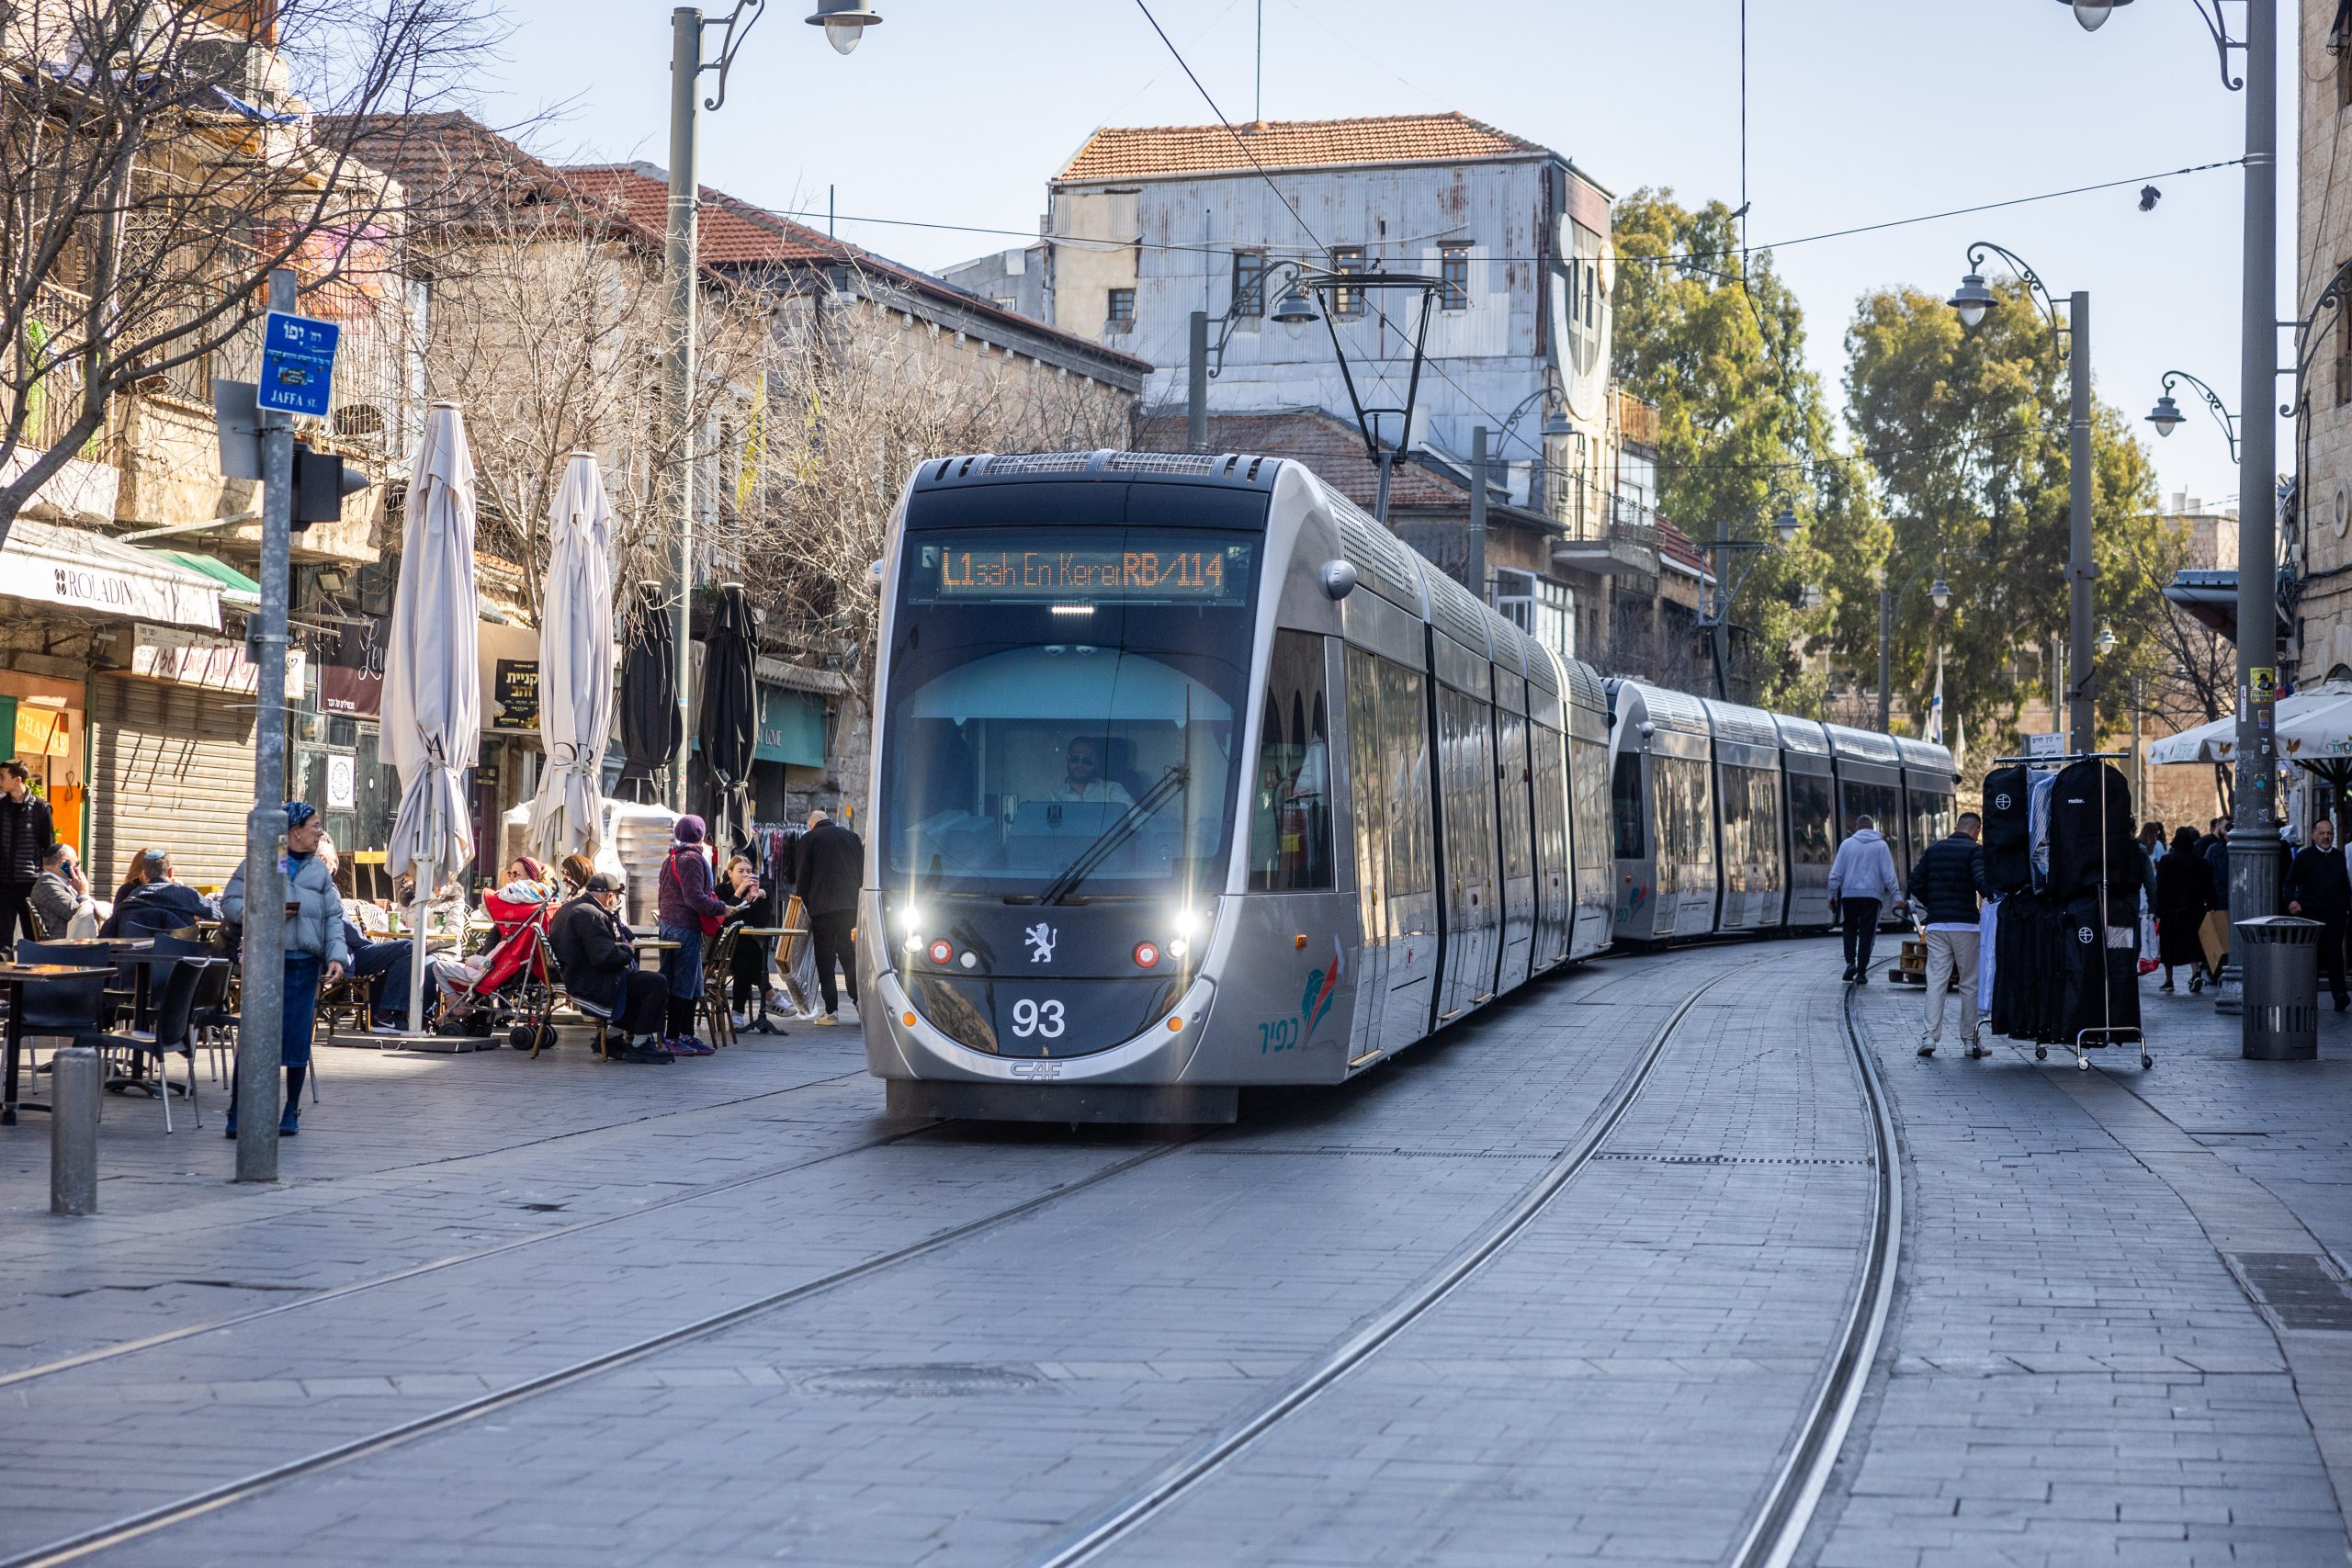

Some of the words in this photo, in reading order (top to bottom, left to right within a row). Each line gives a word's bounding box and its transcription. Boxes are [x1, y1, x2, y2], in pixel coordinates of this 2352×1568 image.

[271, 389, 302, 406] JAFFA
[943, 552, 974, 586] L1
[1024, 552, 1051, 586] En
[1124, 552, 1222, 586] RB/114
[505, 672, 539, 687] קניית
[510, 686, 534, 697] זהב
[17, 711, 67, 751] CHANGE
[1012, 998, 1065, 1038] 93
[1258, 1017, 1299, 1055] כפיר
[1011, 1061, 1062, 1080] CAF
